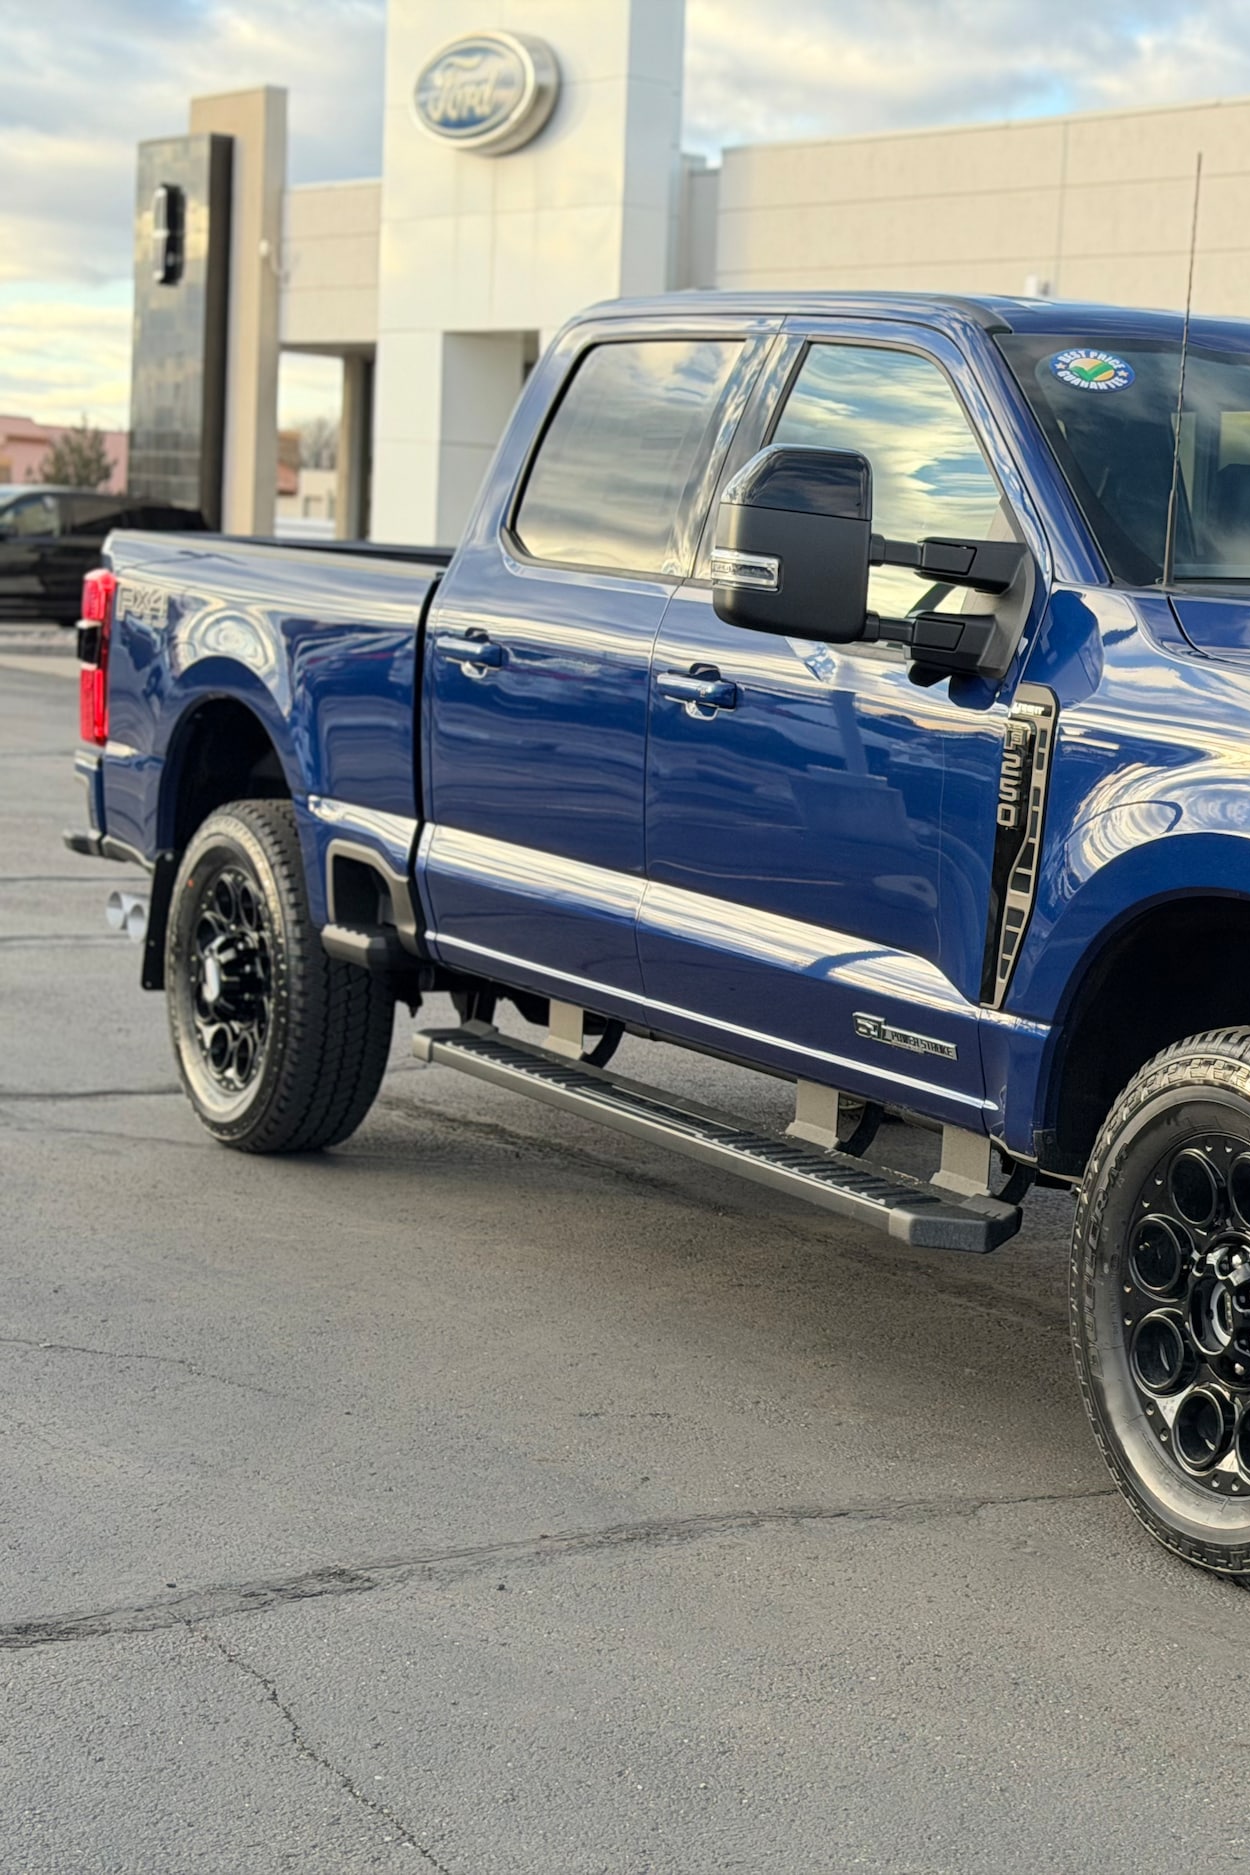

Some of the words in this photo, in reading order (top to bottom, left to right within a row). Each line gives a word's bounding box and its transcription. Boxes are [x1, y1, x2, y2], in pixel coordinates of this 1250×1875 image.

[427, 55, 500, 122] Ford
[1057, 350, 1086, 363] BEST
[1089, 351, 1126, 369] PRICE
[1057, 370, 1128, 390] GUARANTEE
[891, 1031, 920, 1047] POWER
[920, 1039, 954, 1058] STROKE
